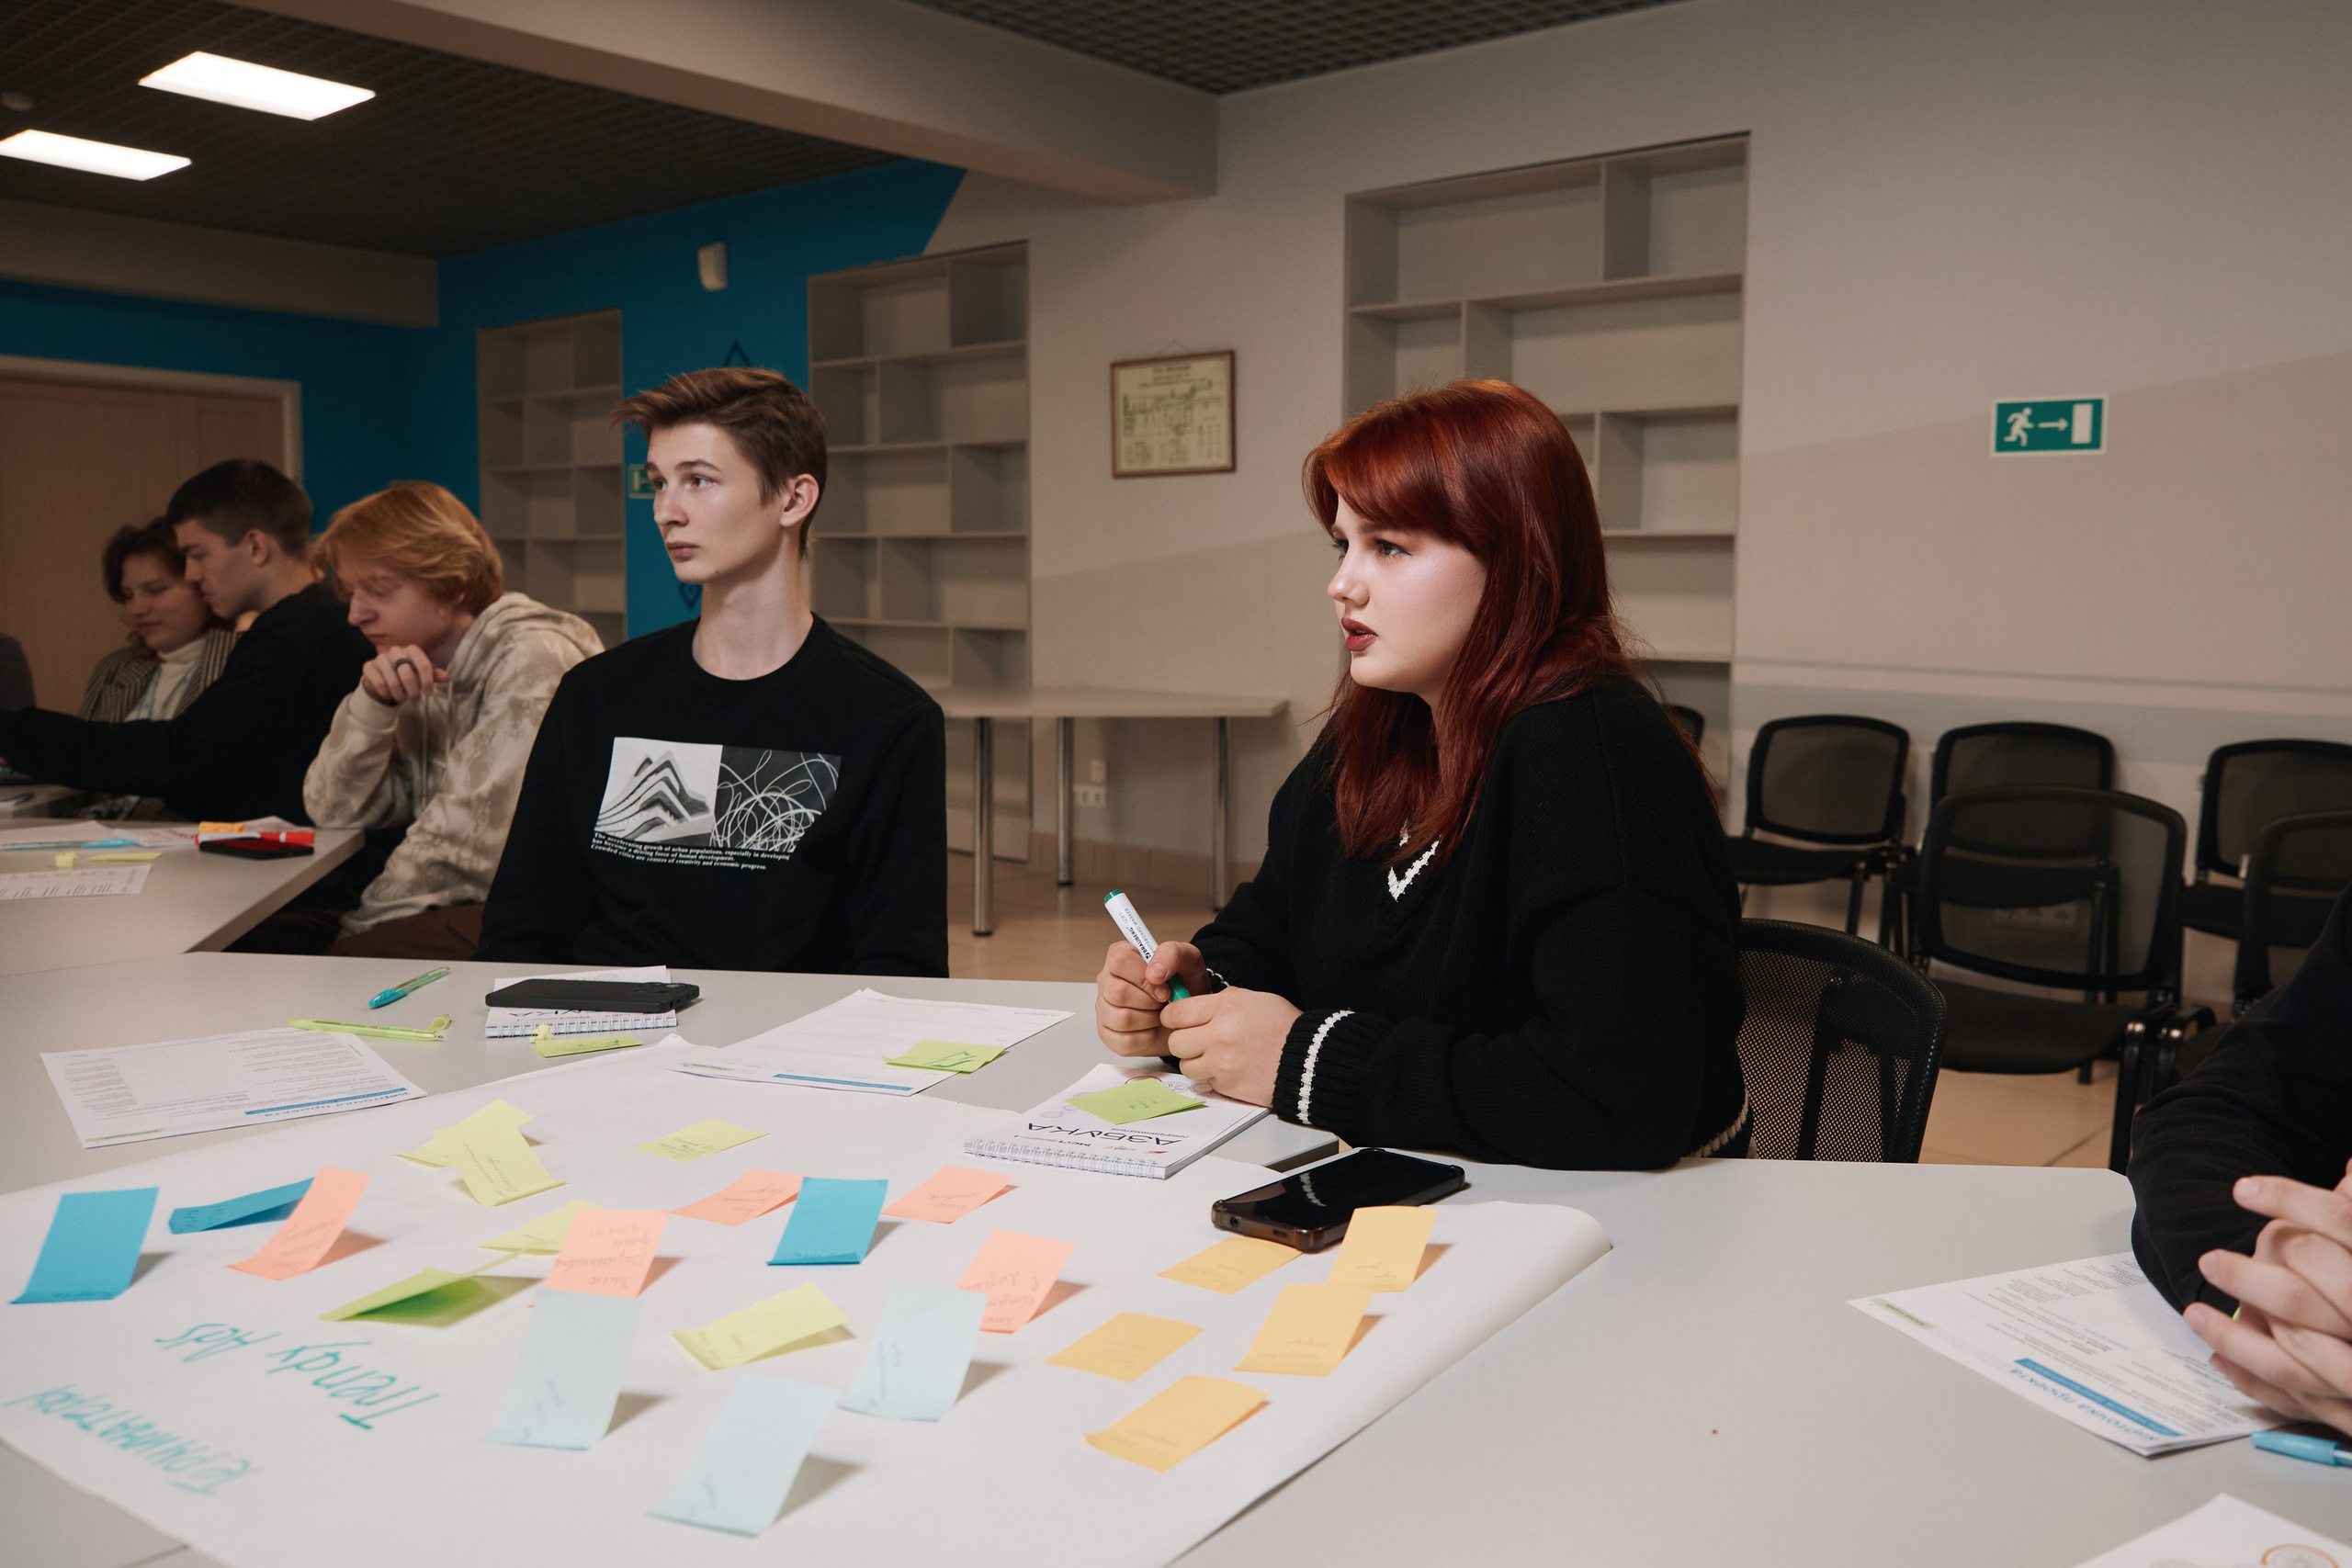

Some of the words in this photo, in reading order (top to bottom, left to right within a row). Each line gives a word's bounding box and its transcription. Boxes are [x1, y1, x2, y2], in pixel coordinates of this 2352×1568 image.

[591, 843, 618, 854] Crowded
[618, 851, 635, 860] cities
[741, 863, 768, 871] progress.
[604, 840, 628, 851] become
[632, 848, 654, 857] driving
[607, 837, 643, 849] accelerating
[643, 843, 663, 852] growth
[724, 850, 752, 859] especially
[760, 852, 790, 861] developing
[1028, 1122, 1182, 1145] АЗБУКА
[266, 1340, 440, 1430] Trendy
